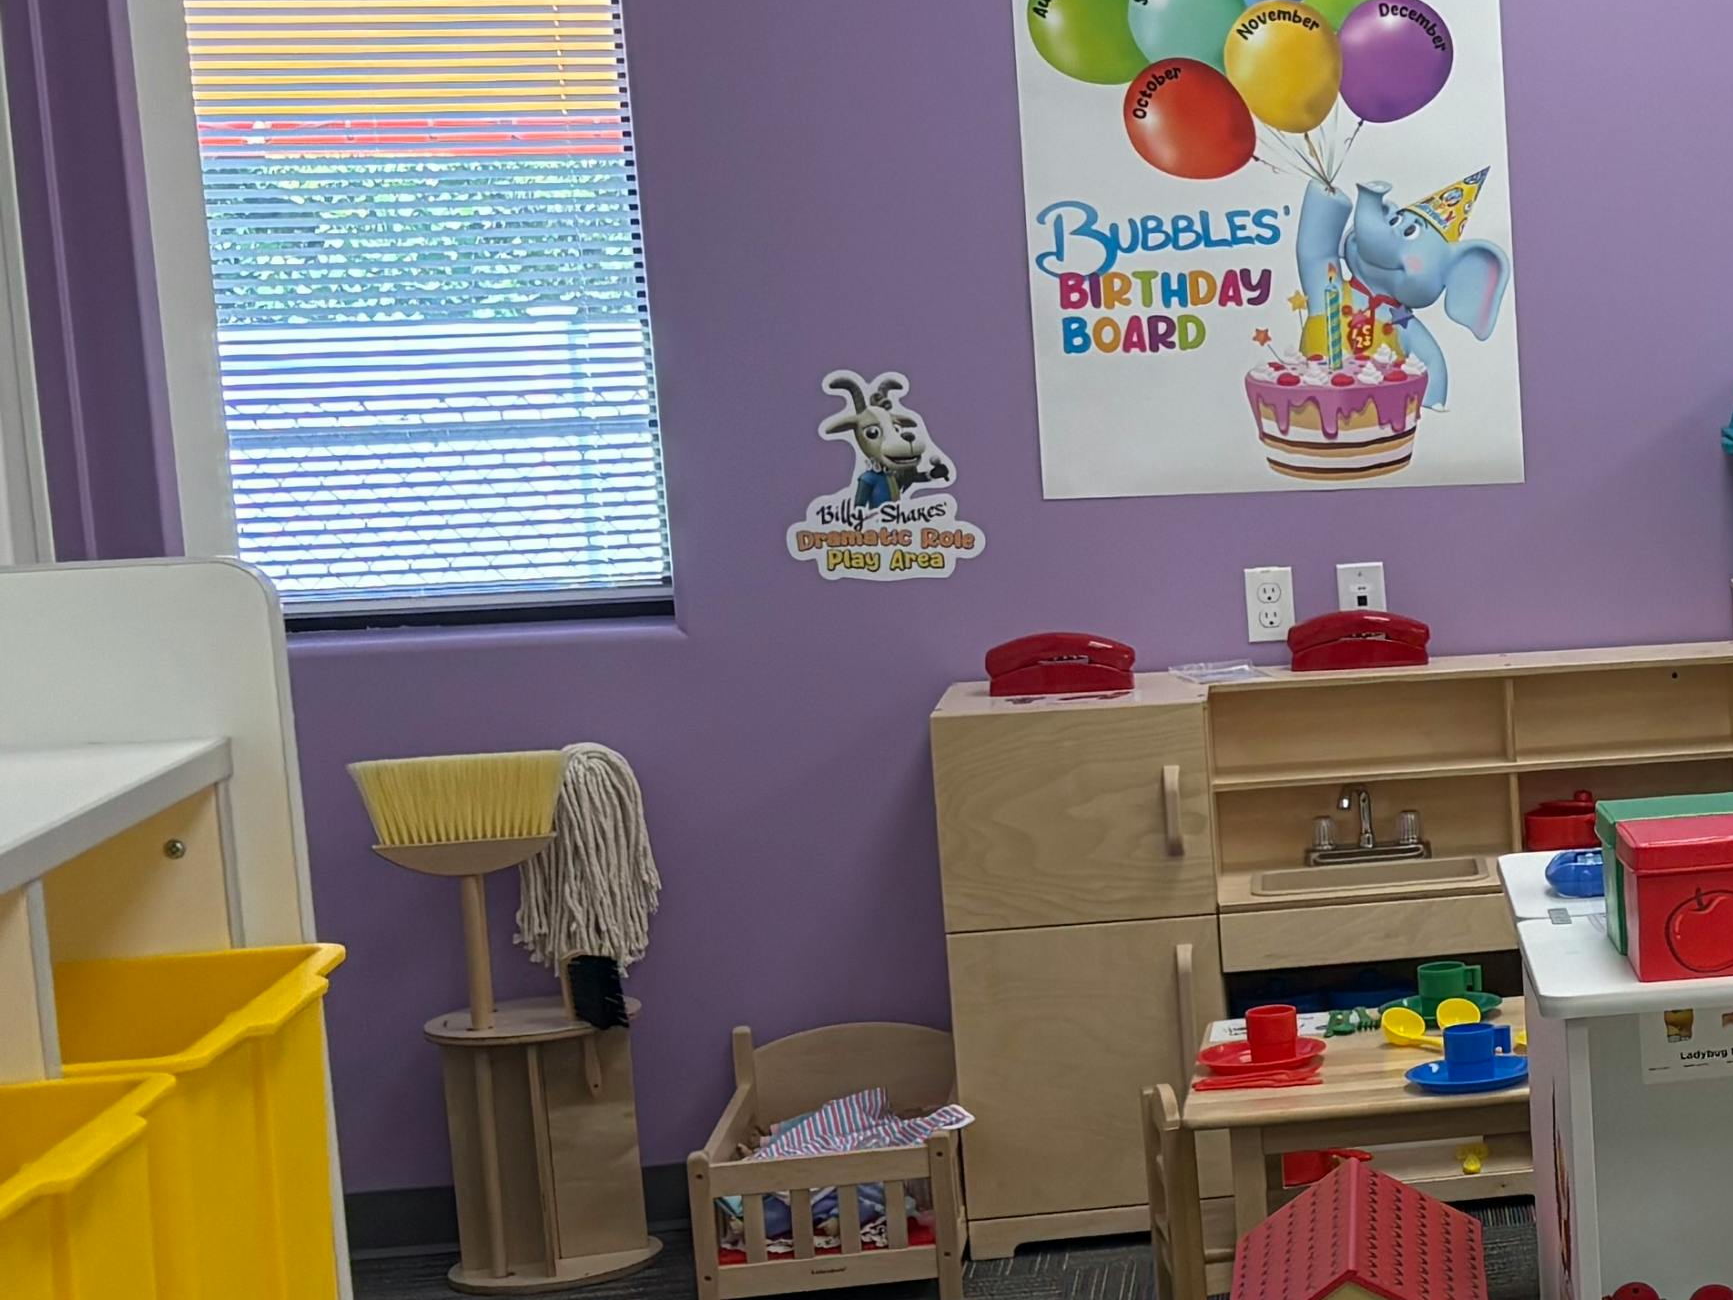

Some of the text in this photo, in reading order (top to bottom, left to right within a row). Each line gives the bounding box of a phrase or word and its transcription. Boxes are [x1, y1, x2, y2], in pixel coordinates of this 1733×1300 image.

[1235, 8, 1321, 42] November
[1378, 1, 1446, 52] December
[1131, 65, 1183, 120] October
[1058, 267, 1272, 311] BIRTHDAY
[1062, 313, 1207, 355] BOARD
[816, 498, 864, 530] Billy
[796, 527, 976, 551] Dramatic Role
[826, 549, 945, 572] Play Area
[1680, 1046, 1728, 1061] Ladybug
